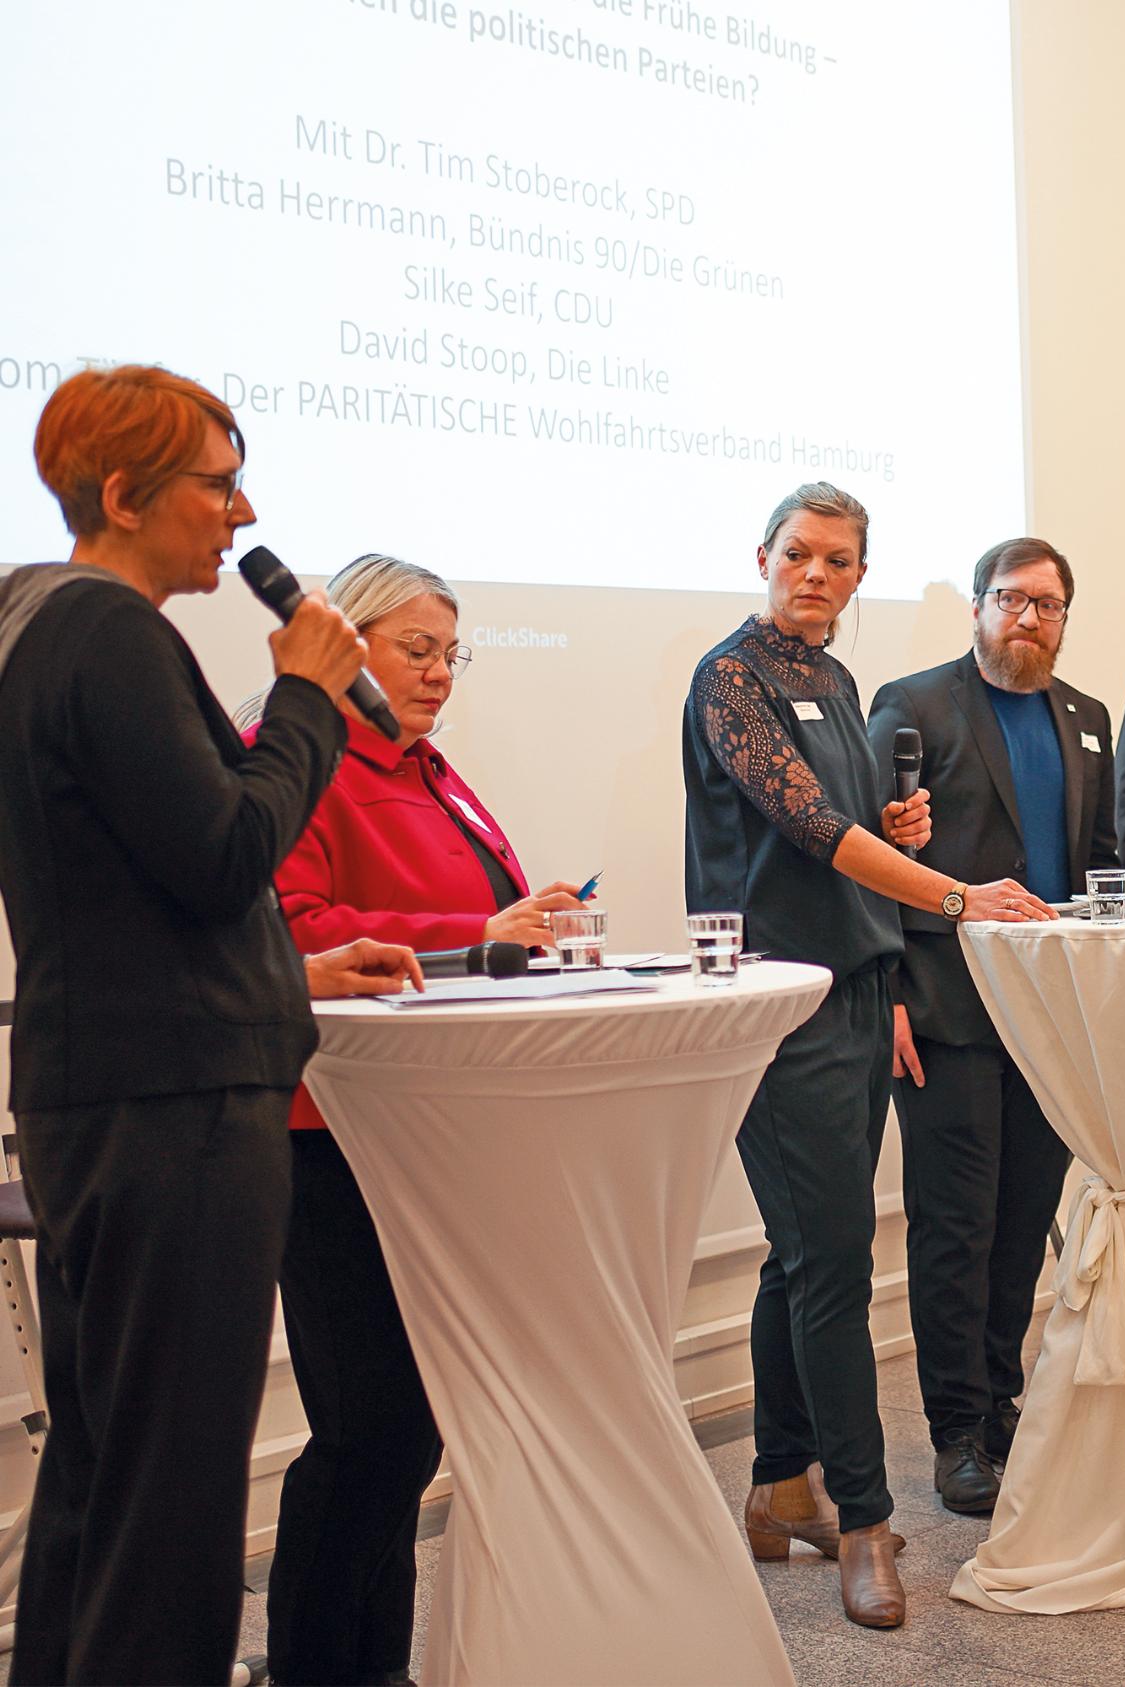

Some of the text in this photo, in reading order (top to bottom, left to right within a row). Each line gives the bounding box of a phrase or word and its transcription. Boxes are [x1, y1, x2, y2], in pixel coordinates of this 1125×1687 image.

[468, 9, 628, 73] politischen
[637, 47, 760, 106] Parteien?
[726, 15, 817, 76] Bildung
[295, 114, 695, 226] Mit Dr. Tim Stoberock, SPD
[165, 157, 784, 299] Britta Herrmann, Bündnis 90/Die Grünen
[403, 265, 613, 329] Silke Seif, CDU
[339, 320, 670, 395] David Stoop, Die Linke
[223, 372, 286, 414] Der
[297, 381, 518, 437] PARITÄTISCHE
[527, 406, 783, 464] Wohlfahrtsverband
[791, 436, 895, 481] Hamburg
[472, 625, 569, 649] ClickShare
